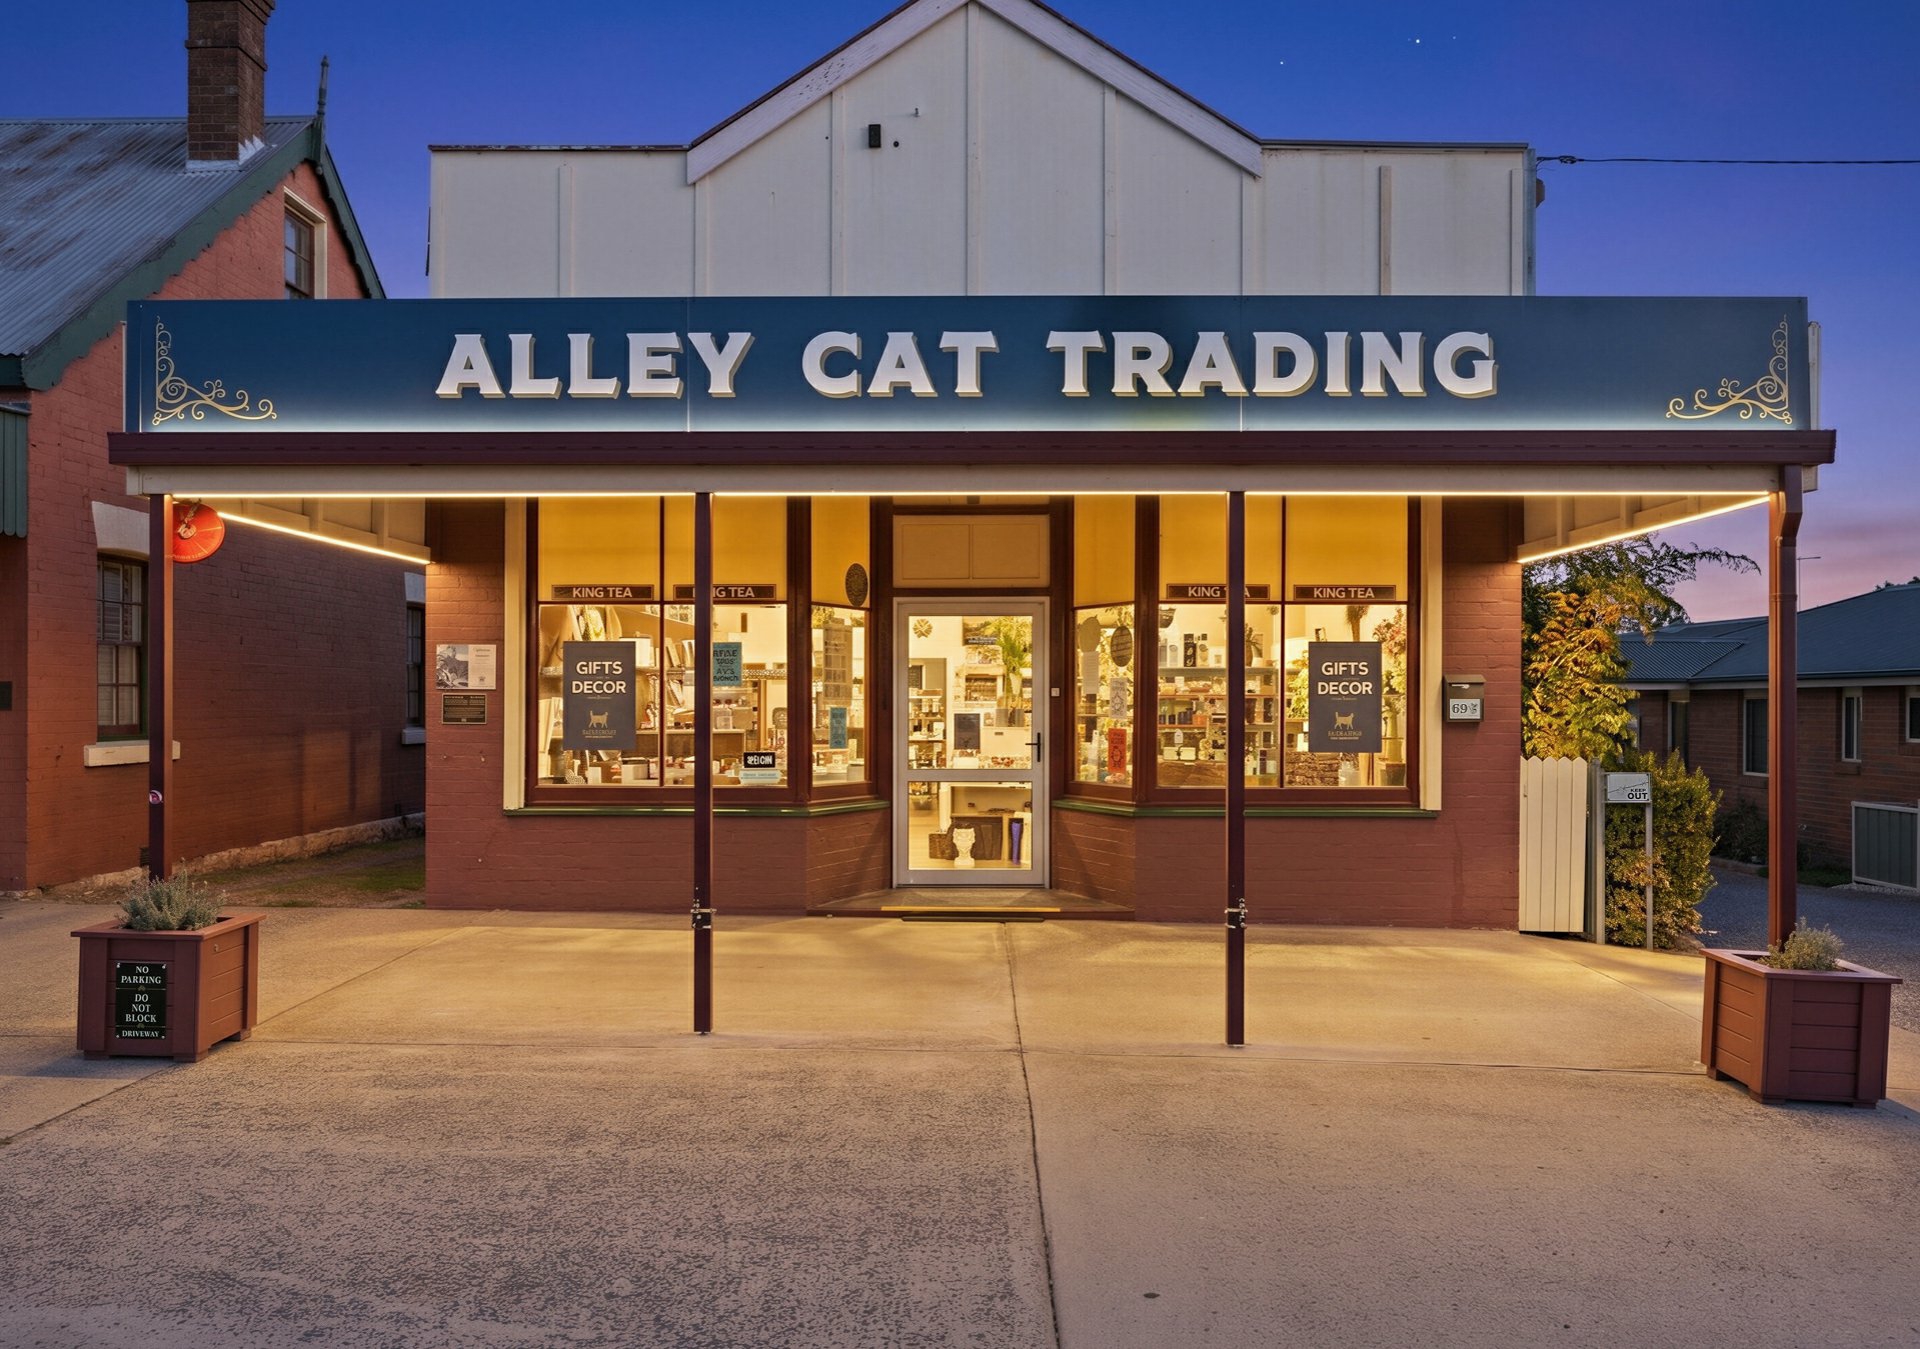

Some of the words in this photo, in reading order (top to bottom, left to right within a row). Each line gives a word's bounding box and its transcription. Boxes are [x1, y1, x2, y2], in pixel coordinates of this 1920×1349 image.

[435, 331, 755, 399] ALLEY
[802, 330, 999, 399] CAT
[1046, 330, 1498, 399] TRADING
[573, 586, 604, 598] KING
[607, 586, 633, 598] TEA
[728, 586, 755, 598] TEA
[1188, 586, 1220, 598] KING
[1313, 587, 1345, 599] KING
[1348, 587, 1375, 599] TEA
[576, 661, 623, 675] GIFTS
[1321, 662, 1369, 676] GIFTS
[572, 680, 626, 694] DECOR
[1317, 681, 1373, 695] DECOR
[1452, 703, 1468, 714] 69
[135, 965, 149, 974] NO
[121, 975, 162, 985] PARKING
[134, 993, 149, 1002] DO
[131, 1003, 151, 1013] NOT
[125, 1013, 157, 1023] BLOCK
[121, 1030, 160, 1038] DRIVEWAY
